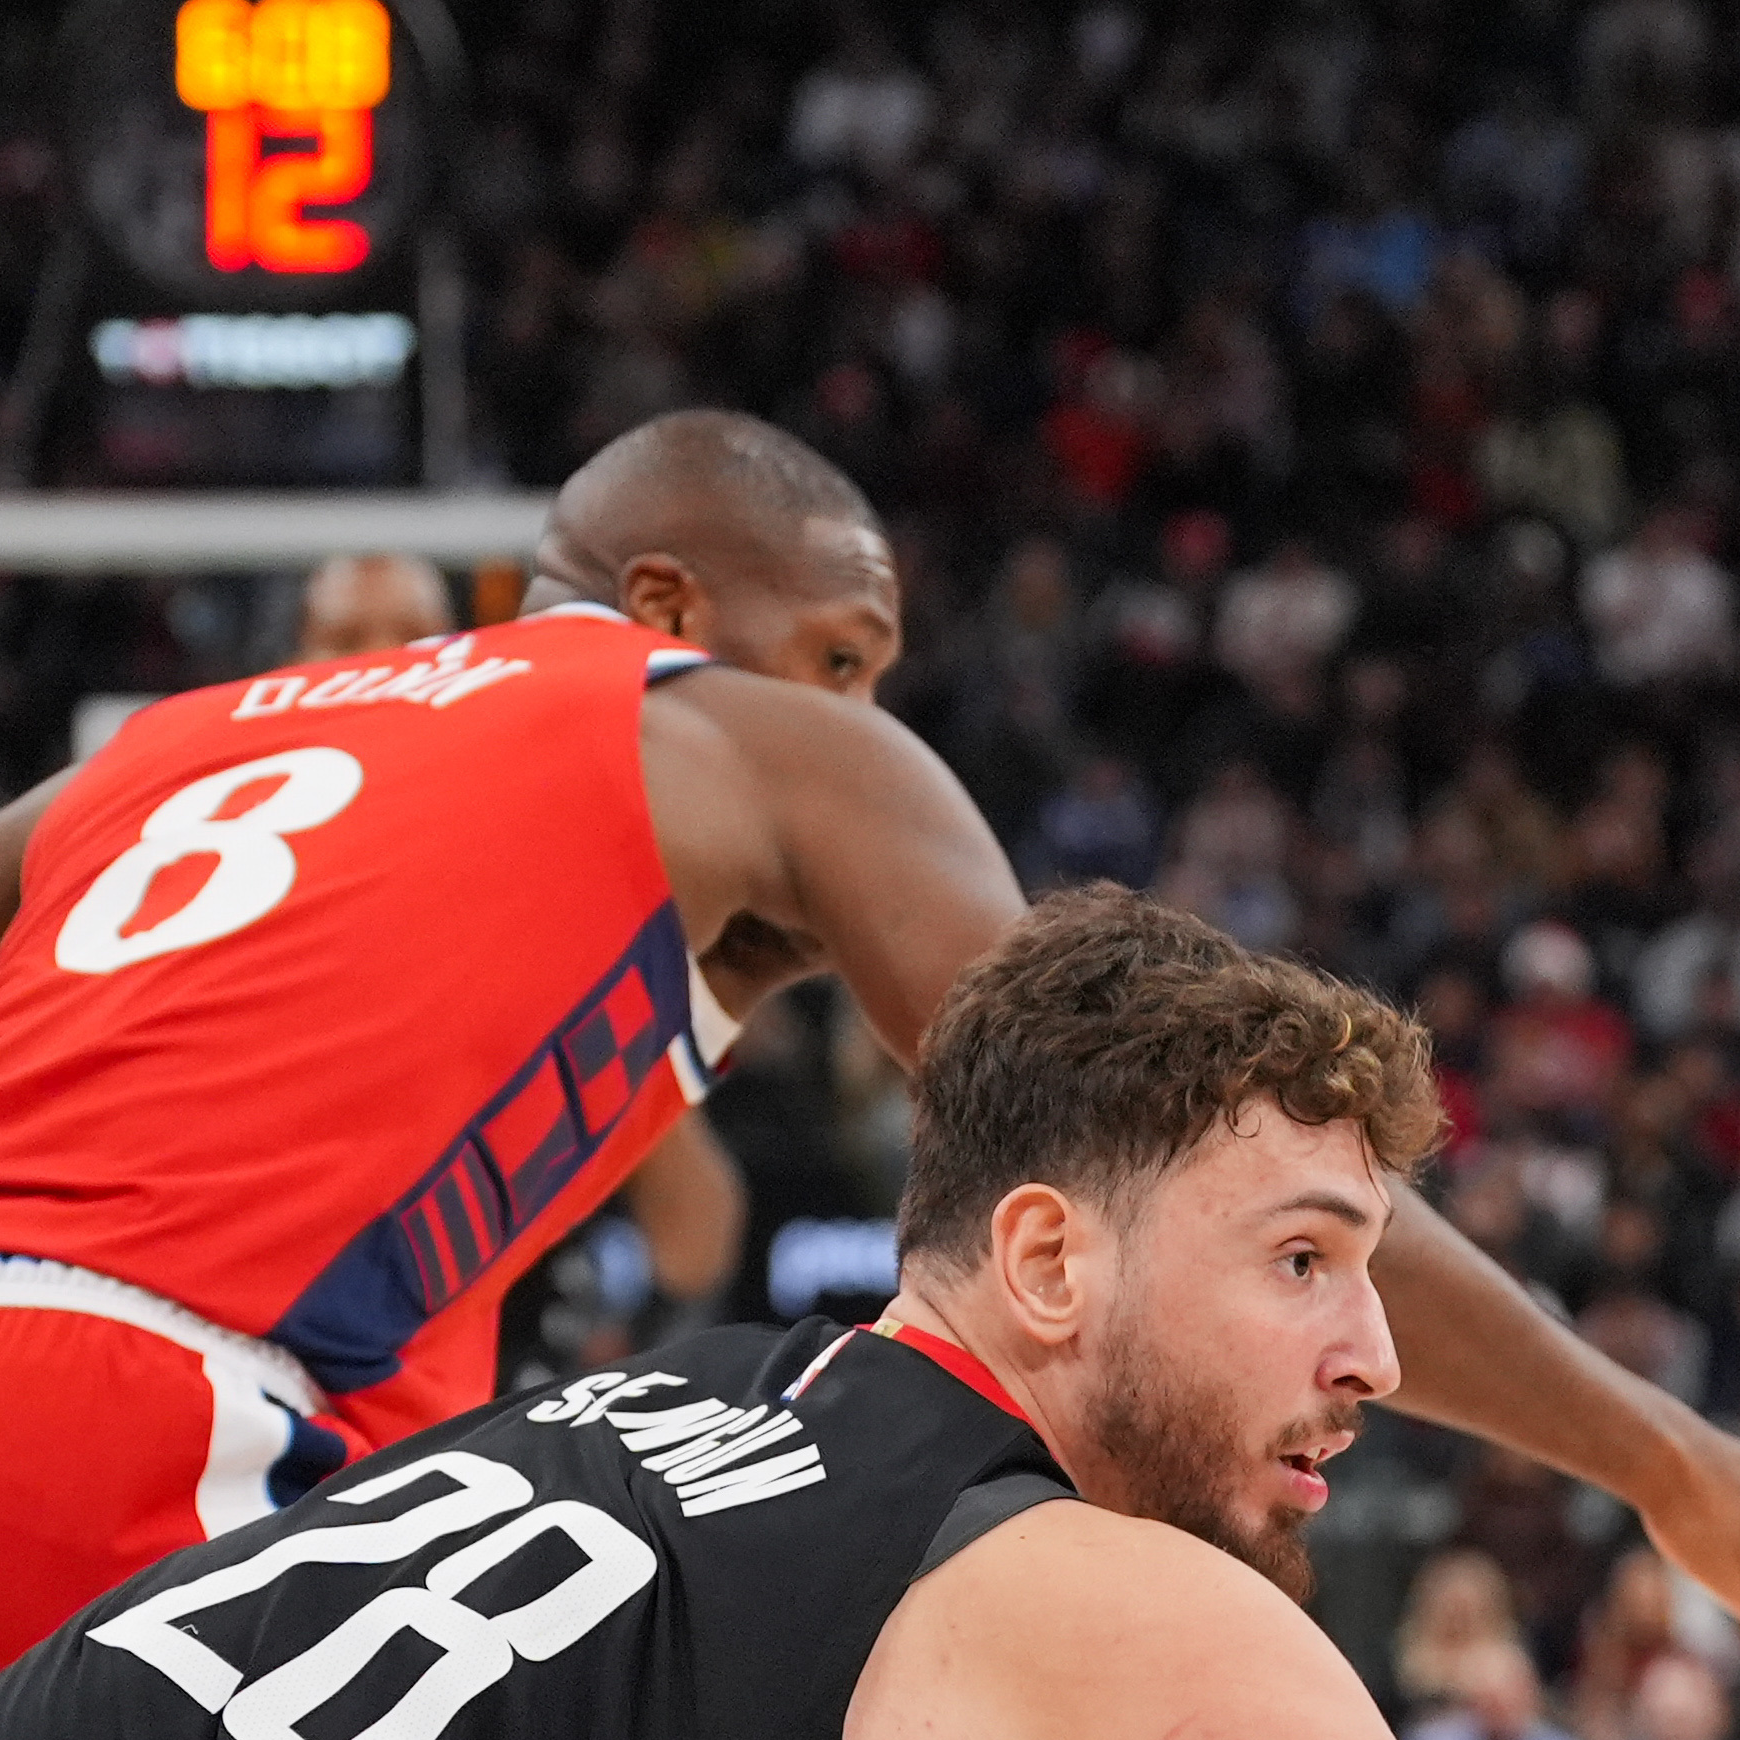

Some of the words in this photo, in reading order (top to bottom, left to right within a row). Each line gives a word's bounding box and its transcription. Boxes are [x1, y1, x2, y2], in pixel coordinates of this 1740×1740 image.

[206, 106, 374, 272] 12
[229, 657, 533, 721] DUNN
[55, 747, 362, 974] 8
[526, 1371, 827, 1518] SENGUN
